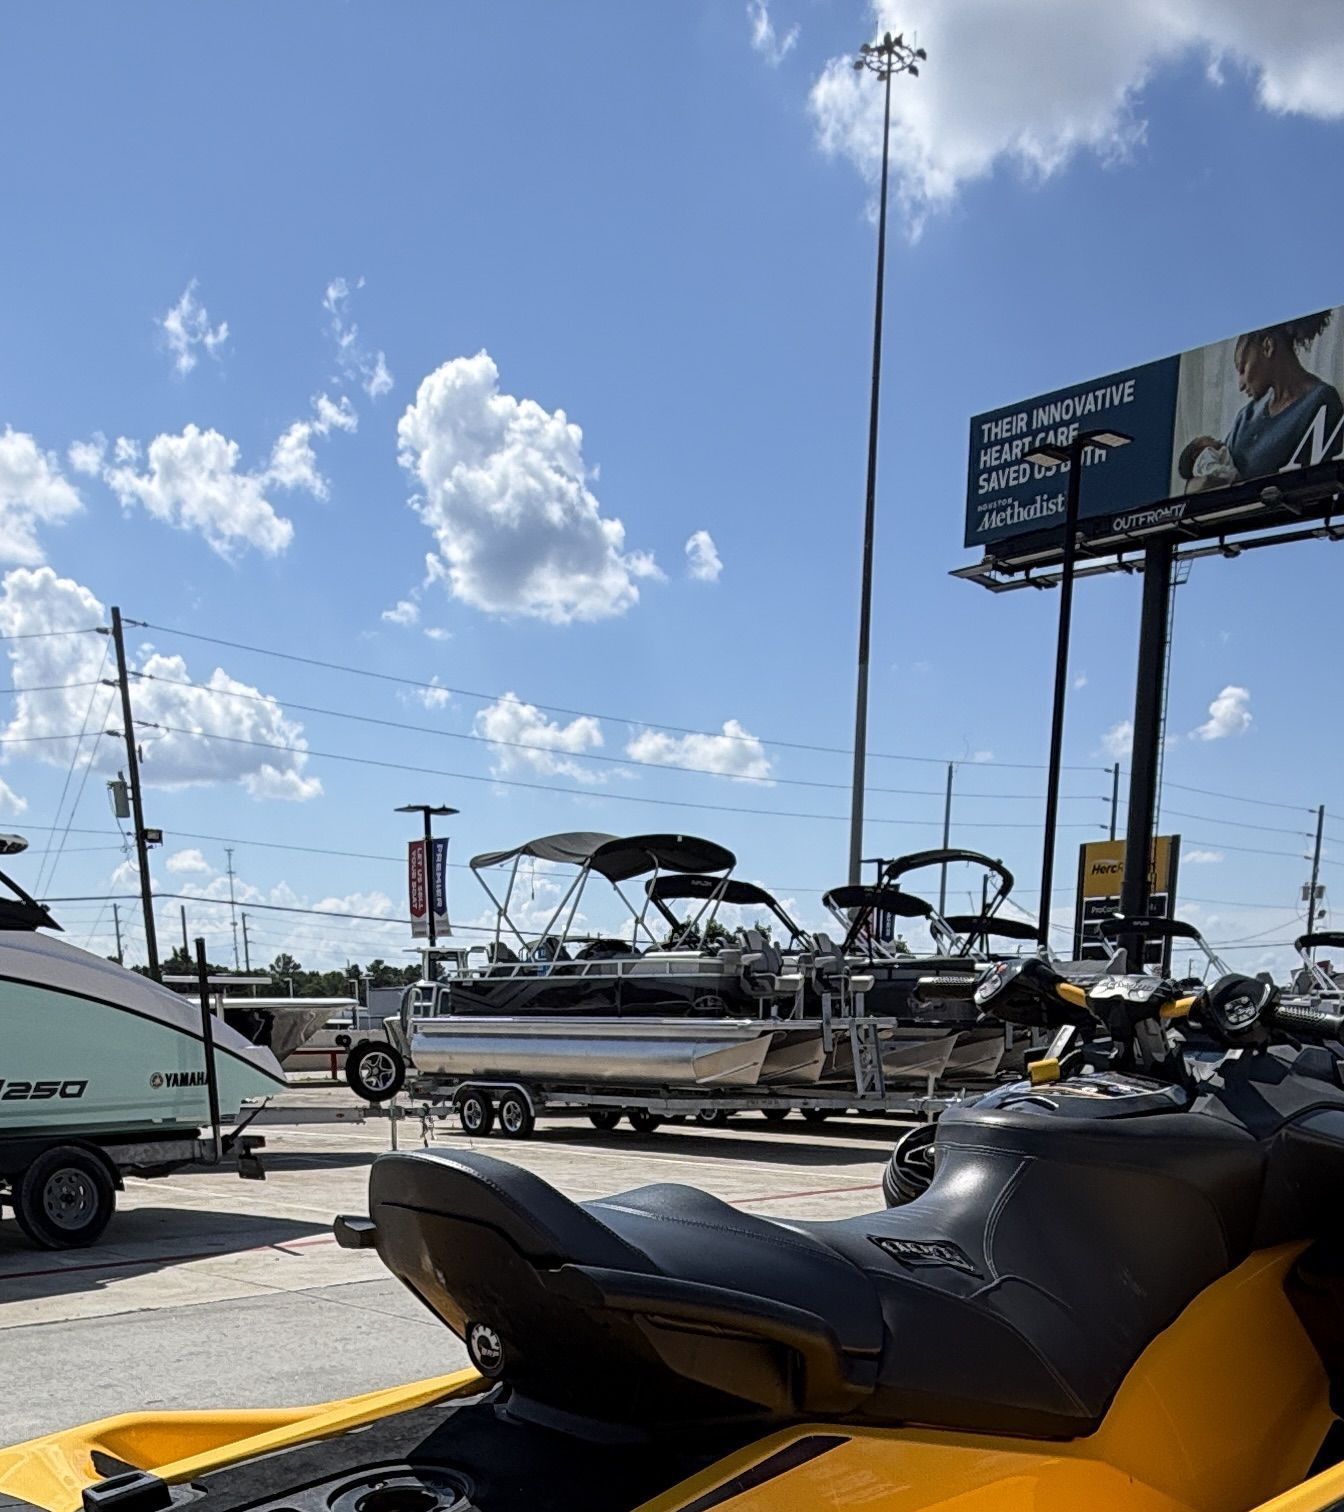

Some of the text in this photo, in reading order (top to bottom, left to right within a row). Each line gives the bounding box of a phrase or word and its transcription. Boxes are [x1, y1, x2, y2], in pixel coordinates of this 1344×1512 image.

[981, 379, 1136, 444] THEIR INNOVATIVE
[977, 463, 1031, 495] SAVED
[1060, 445, 1107, 474] BTH
[979, 435, 1033, 470] HEART
[976, 492, 1066, 533] Methodist
